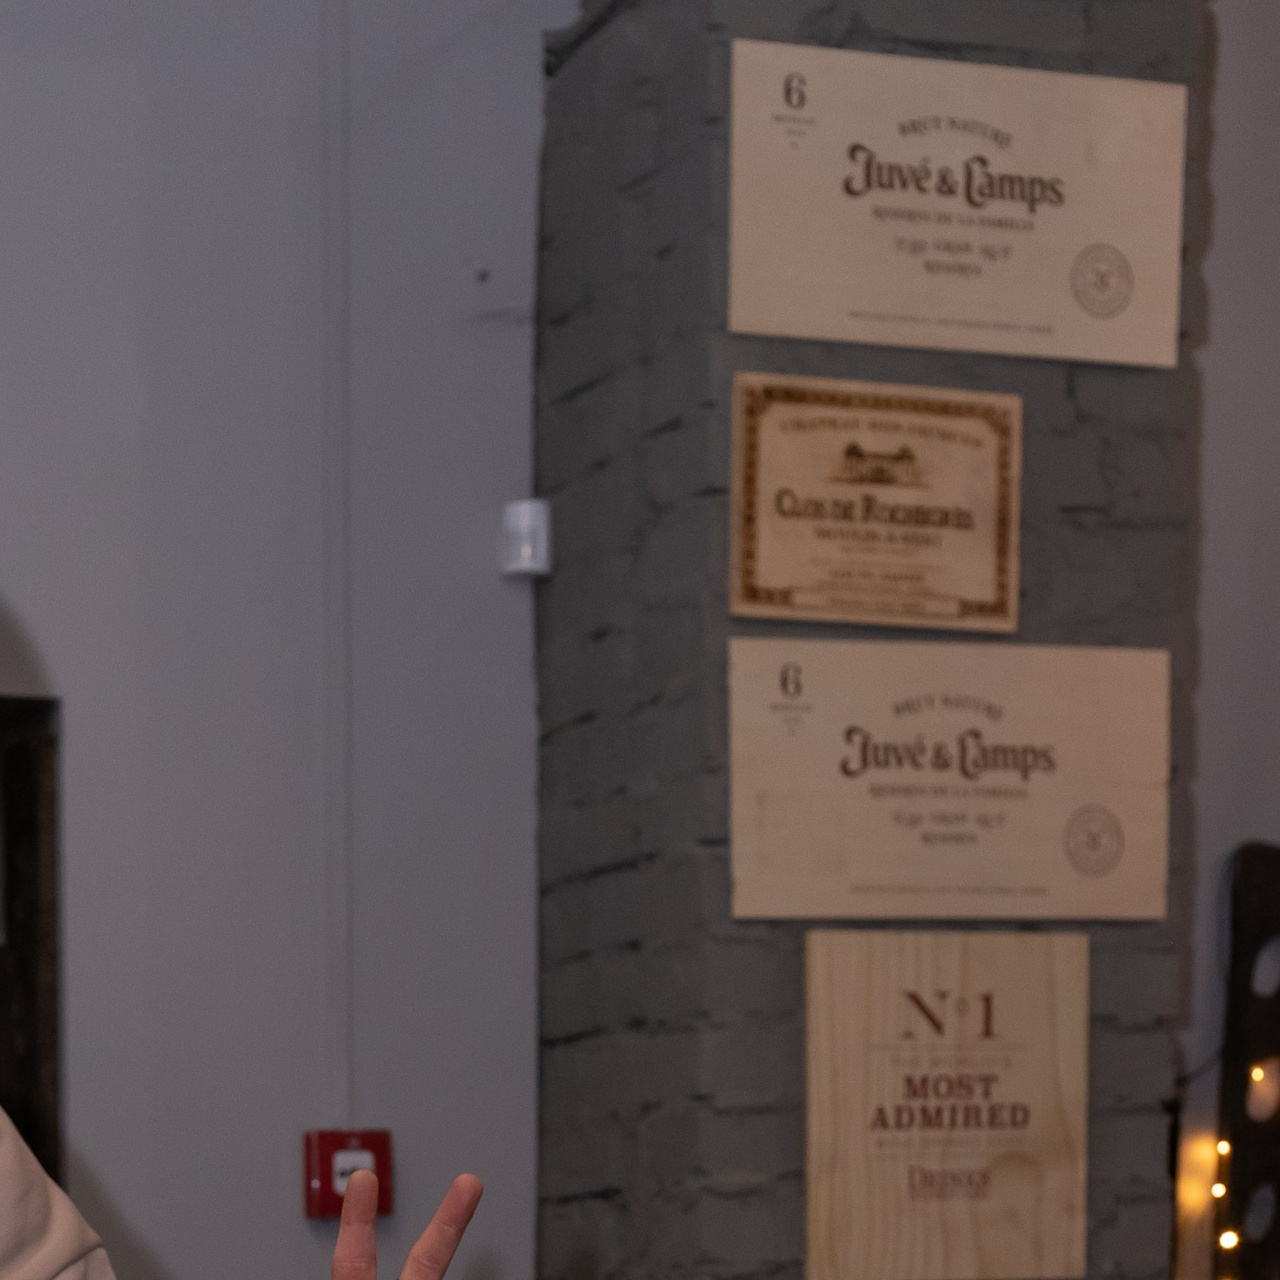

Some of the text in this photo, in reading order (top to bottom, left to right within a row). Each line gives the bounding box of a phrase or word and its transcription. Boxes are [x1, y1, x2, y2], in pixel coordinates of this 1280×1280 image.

[782, 72, 808, 110] 6
[843, 143, 1066, 214] Juvé & Camps
[779, 662, 804, 698] 6
[839, 724, 925, 778] Juvé
[930, 741, 953, 772] &
[959, 727, 1058, 782] Camps
[903, 1074, 999, 1100] MOST
[870, 1104, 1031, 1131] ADMIRED
